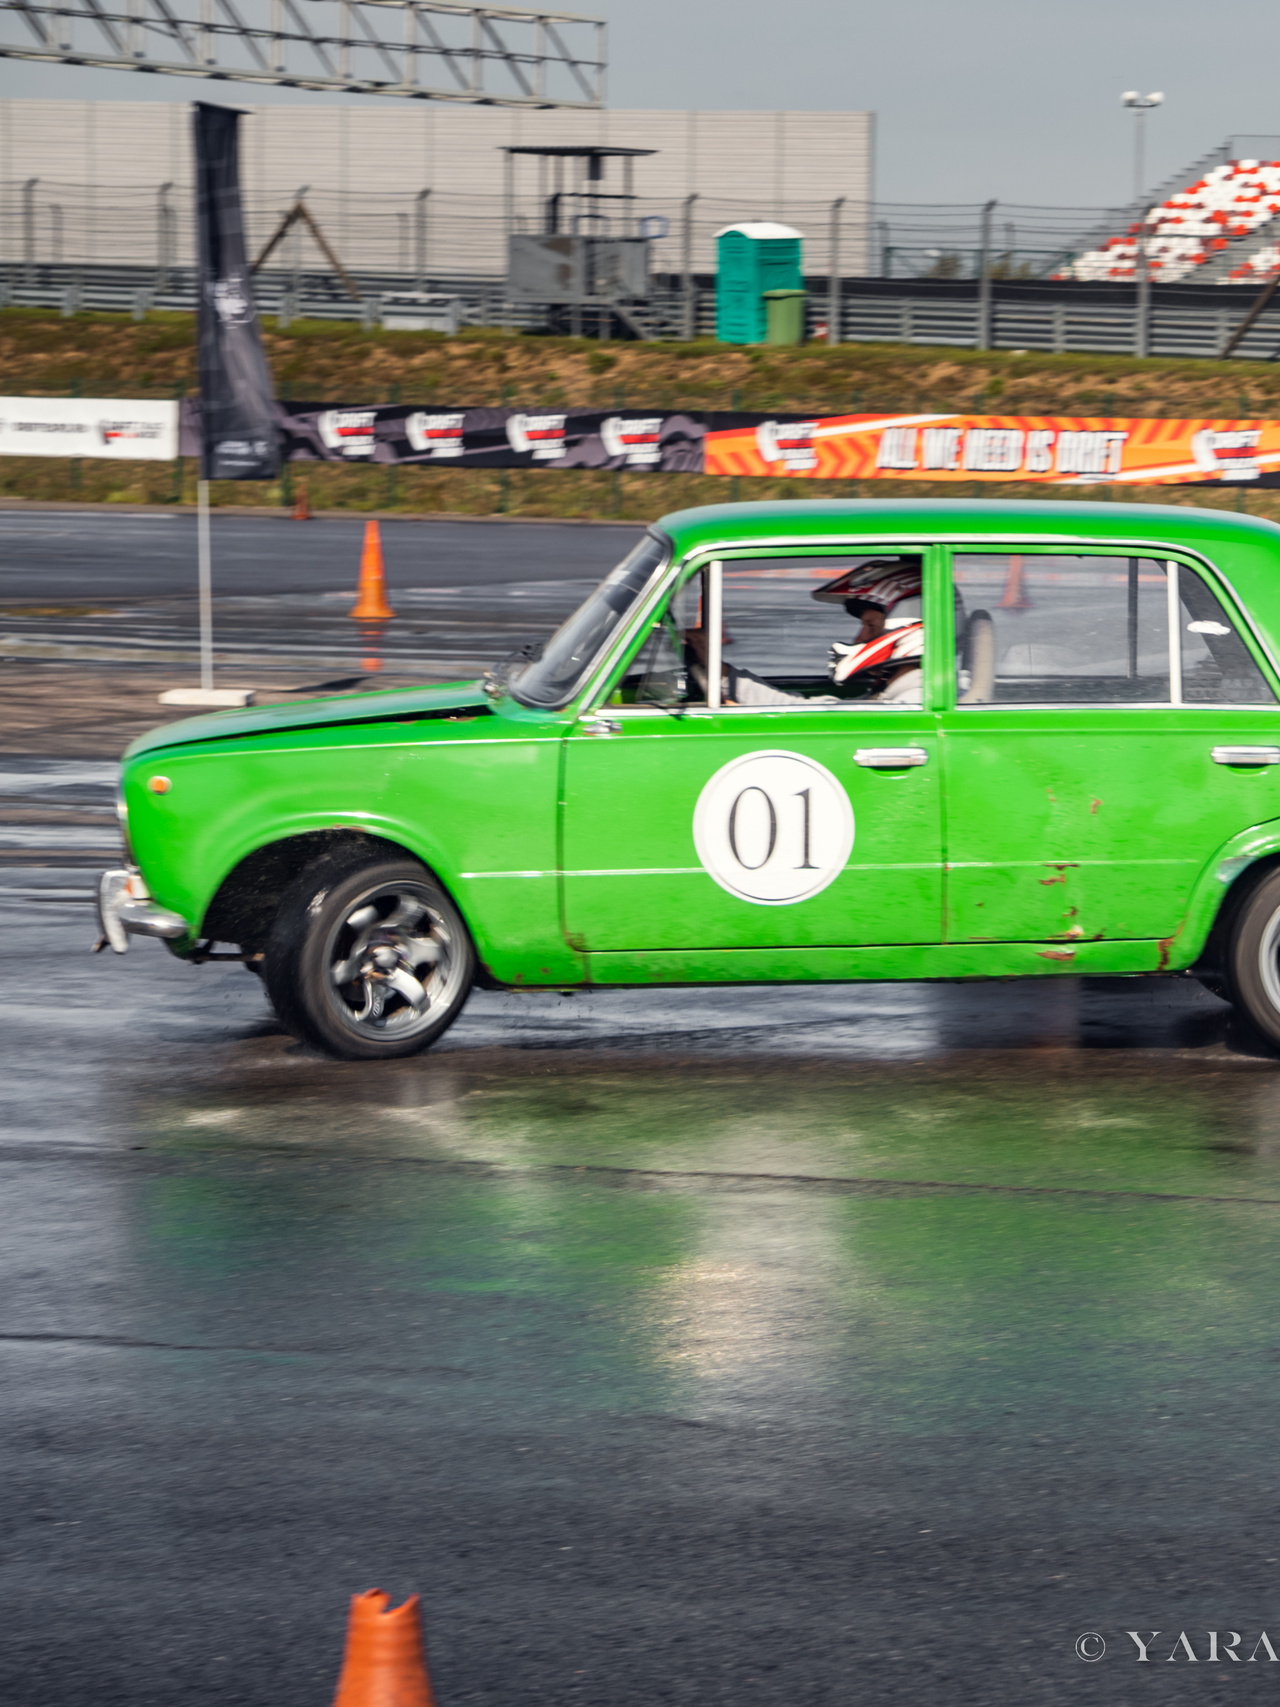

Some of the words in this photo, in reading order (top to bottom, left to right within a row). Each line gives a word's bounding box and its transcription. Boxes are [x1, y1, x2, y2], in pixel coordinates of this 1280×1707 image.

[876, 427, 919, 469] ALL
[922, 427, 963, 470] WE
[963, 428, 1025, 472] NEED
[1024, 430, 1055, 473] IS
[1055, 430, 1129, 474] DRIFT
[729, 786, 820, 870] 01
